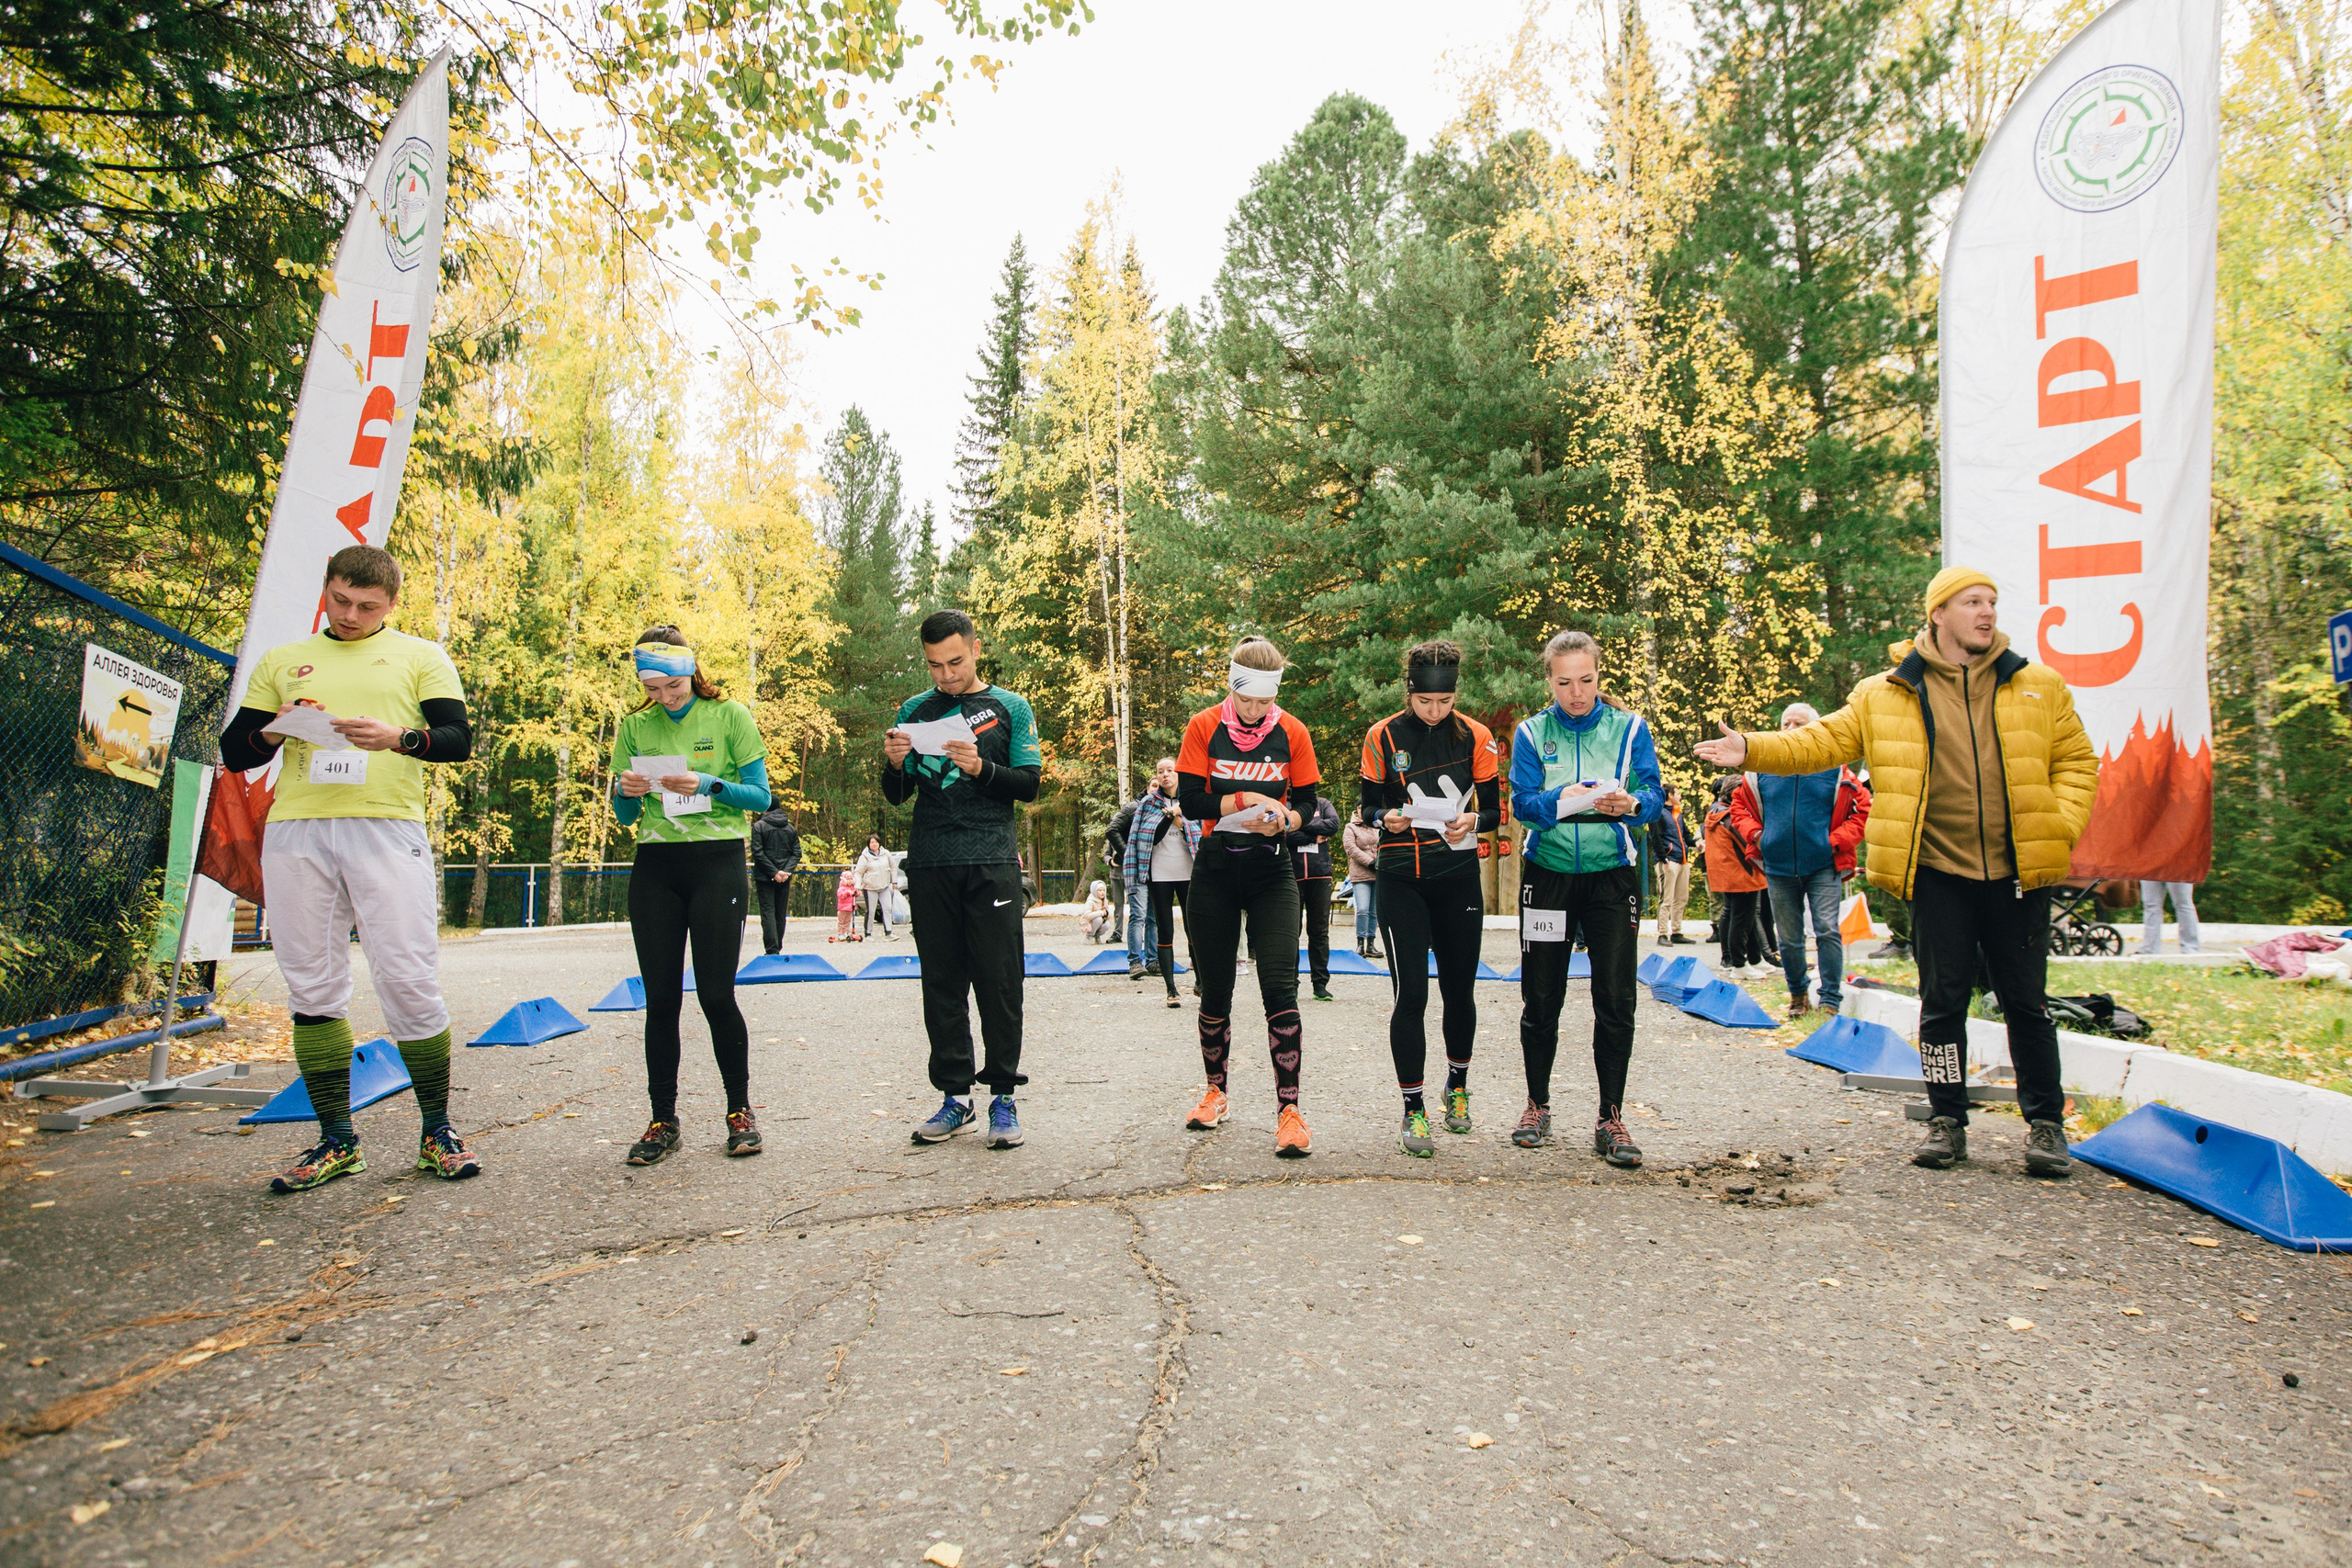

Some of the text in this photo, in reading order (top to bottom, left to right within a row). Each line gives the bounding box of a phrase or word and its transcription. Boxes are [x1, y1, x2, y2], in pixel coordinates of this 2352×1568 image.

[2034, 254, 2143, 688] СТАРТ
[2332, 624, 2352, 674] P
[93, 653, 178, 701] АЛЛЕЯ ЗДОРОВЬЯ
[324, 761, 350, 773] 401
[1532, 920, 1554, 932] 403
[1278, 1054, 1297, 1063] LOVER
